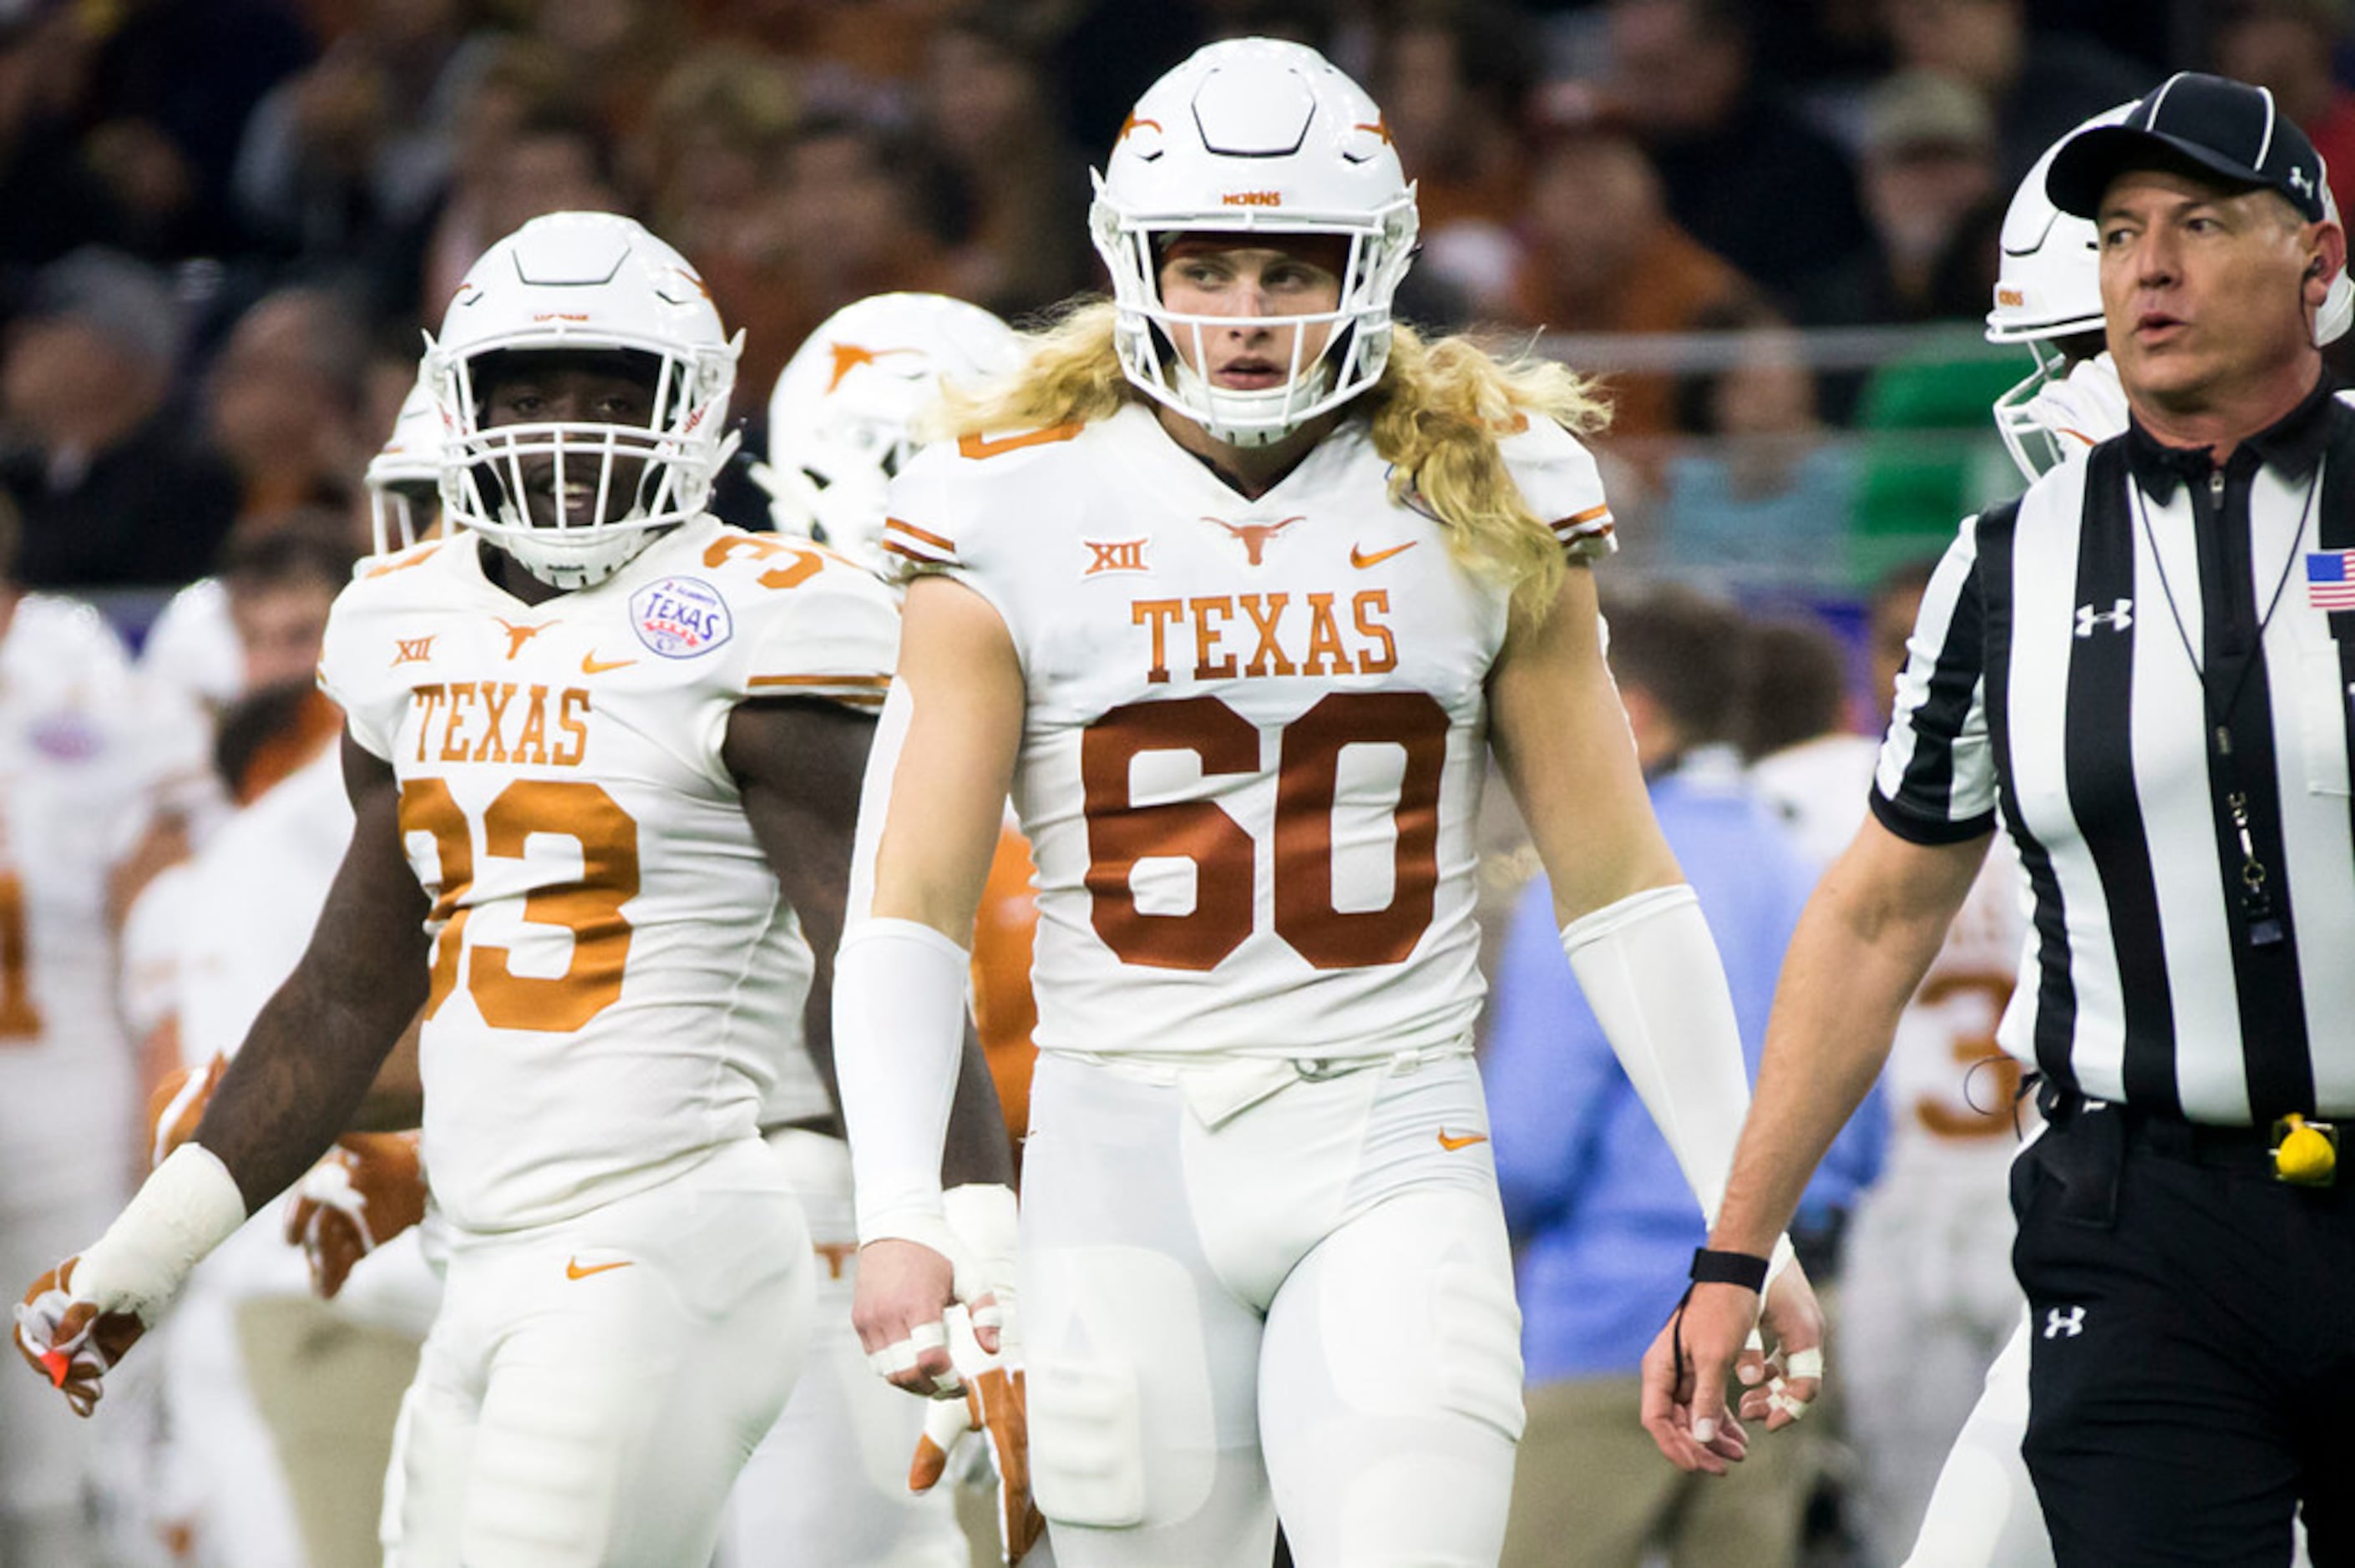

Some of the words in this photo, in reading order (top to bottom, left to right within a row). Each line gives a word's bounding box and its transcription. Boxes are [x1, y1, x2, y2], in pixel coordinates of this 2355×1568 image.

[1222, 191, 1281, 207] HORNS
[1084, 539, 1150, 574] XII
[645, 592, 720, 641] TEXAS
[1131, 589, 1397, 684] TEXAS
[389, 635, 436, 668] XII
[410, 680, 590, 766] TEXAS
[1081, 692, 1451, 972] 60
